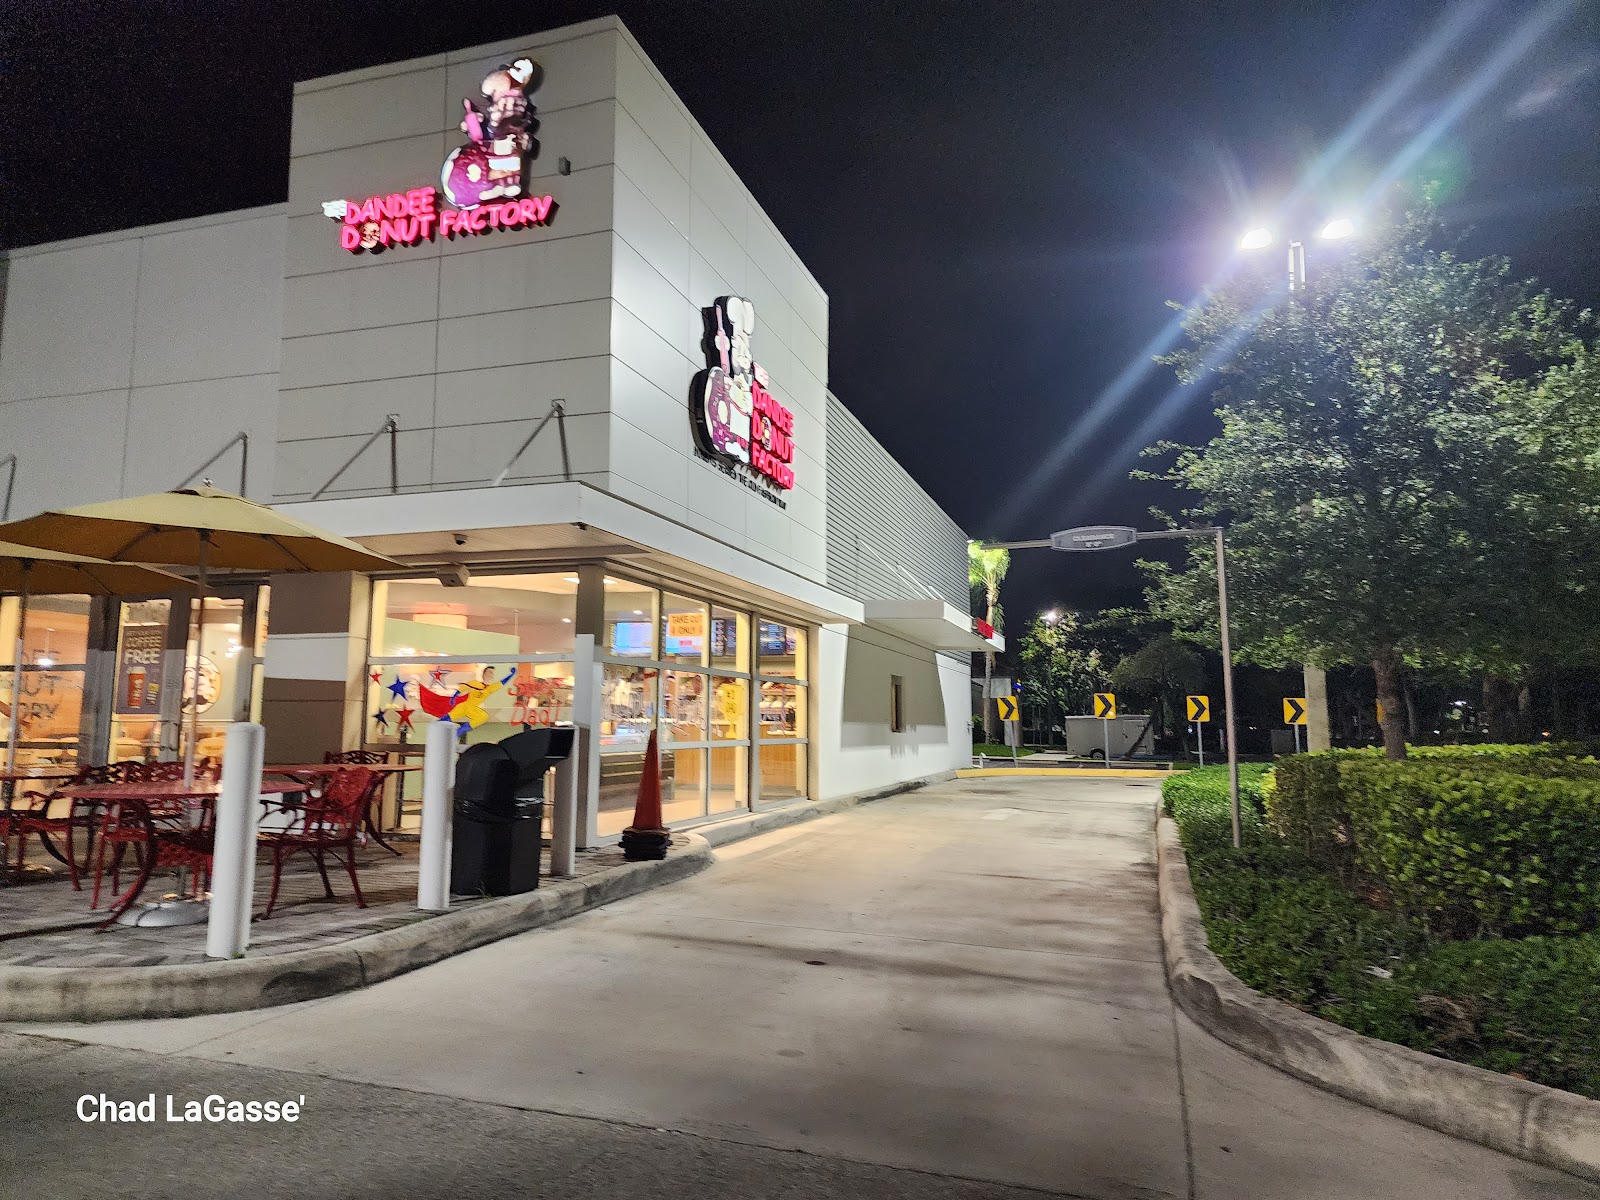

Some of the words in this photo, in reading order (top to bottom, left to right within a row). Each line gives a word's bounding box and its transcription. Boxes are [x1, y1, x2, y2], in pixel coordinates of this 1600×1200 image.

[341, 213, 437, 249] DONUT
[440, 195, 553, 237] FACTORY
[344, 187, 436, 225] DANDEE
[751, 380, 795, 437] DANDEE
[751, 408, 795, 464] DONUT
[751, 441, 795, 490] FACTORY
[124, 647, 161, 665] FREE
[125, 636, 163, 648] COFFEE
